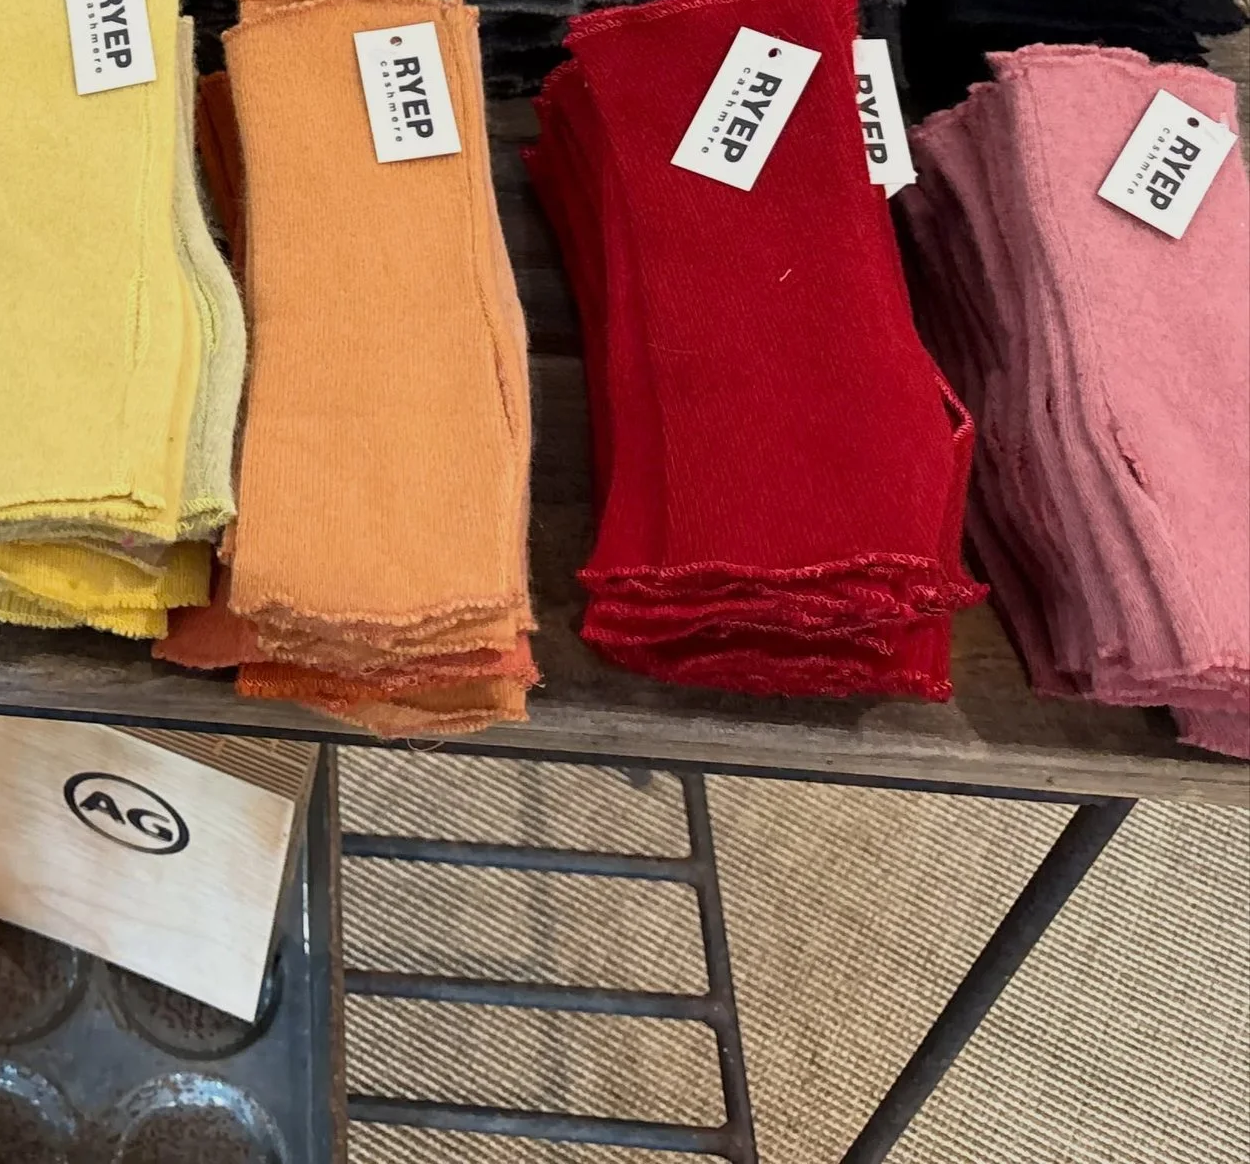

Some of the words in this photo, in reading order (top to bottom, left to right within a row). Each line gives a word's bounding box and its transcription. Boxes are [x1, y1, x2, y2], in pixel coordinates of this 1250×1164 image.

[380, 60, 403, 143] cashmere
[393, 56, 434, 139] RYEP
[700, 67, 751, 154] cashmere
[721, 71, 783, 163] RYEP
[1127, 127, 1171, 195] cashmere
[1145, 135, 1202, 211] RYEP
[79, 790, 174, 842] AG
